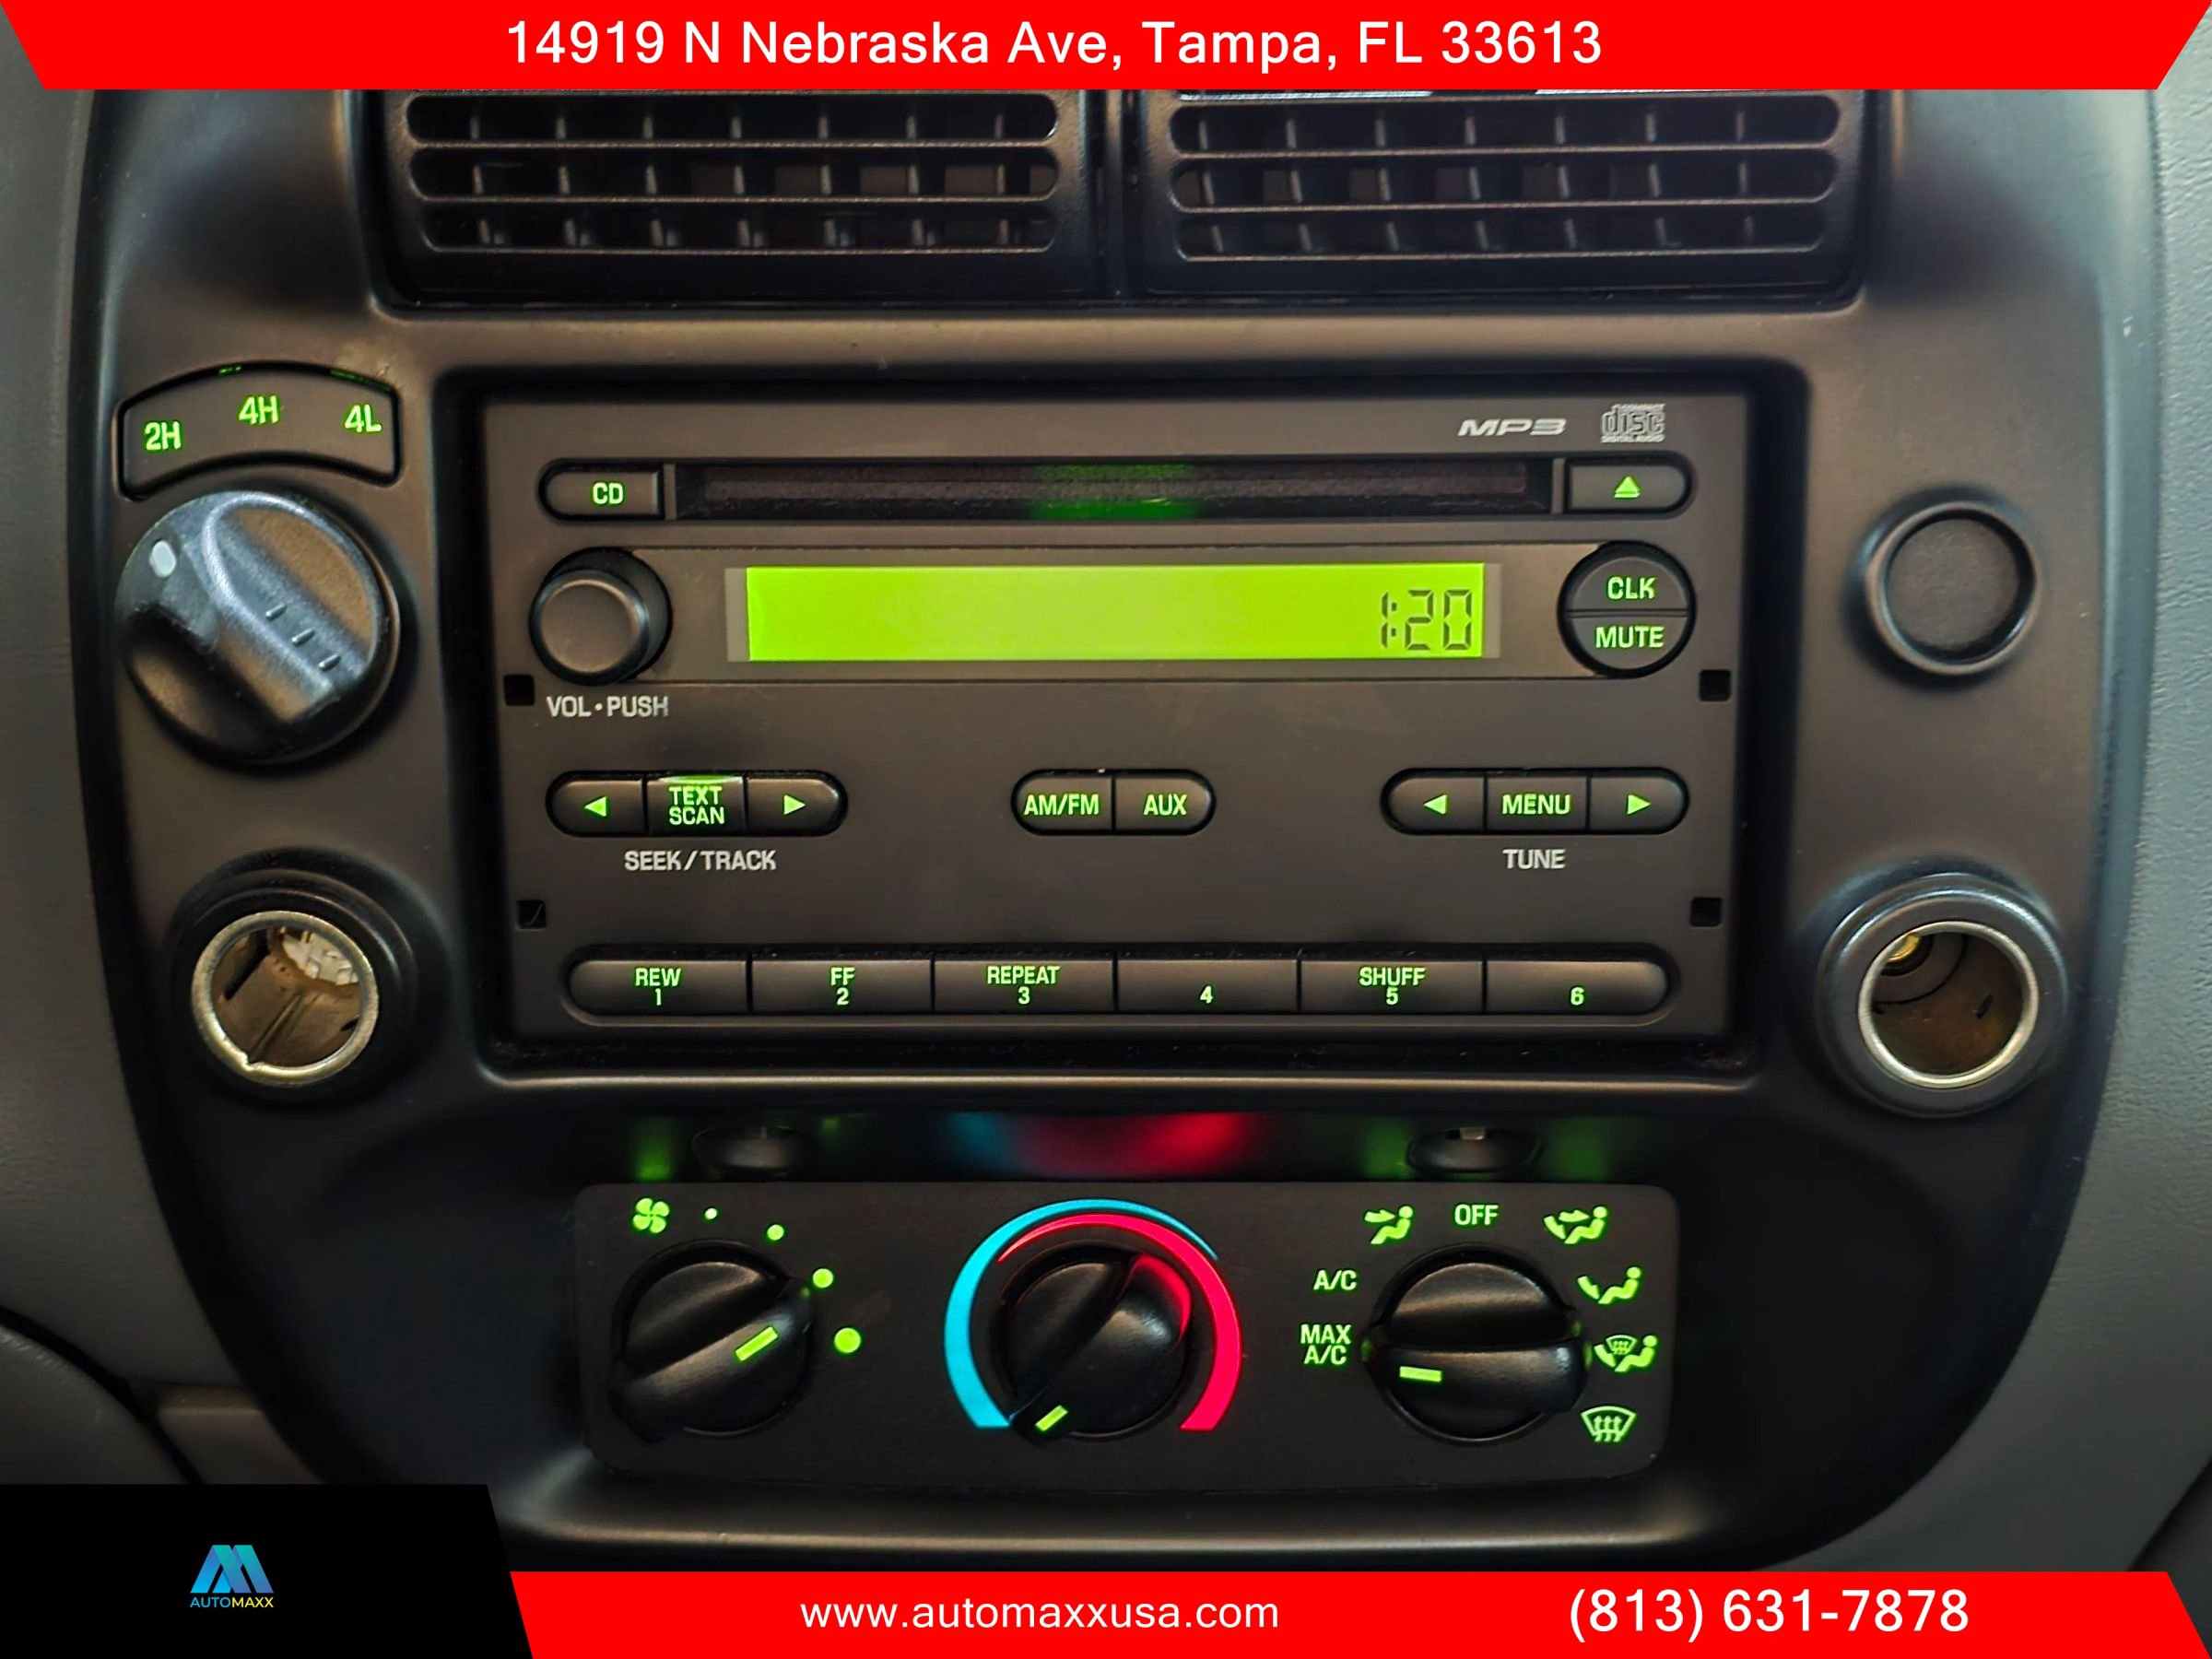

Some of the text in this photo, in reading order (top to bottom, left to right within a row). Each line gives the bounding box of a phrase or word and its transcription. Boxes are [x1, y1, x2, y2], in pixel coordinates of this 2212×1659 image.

[238, 395, 279, 425] 4H
[344, 404, 382, 433] 4L
[144, 421, 182, 451] 2H
[1457, 418, 1567, 437] MP3
[592, 482, 624, 505] CD
[1607, 576, 1655, 600] CLK
[1381, 589, 1472, 651] 1:20
[1595, 625, 1665, 649] MUTE
[668, 786, 723, 806] TEXT
[1024, 793, 1100, 816] AM/FM
[1143, 793, 1188, 816] AUX
[1501, 793, 1571, 815] MENU
[668, 806, 725, 826] SCAN
[1502, 849, 1565, 869] TUNE
[635, 967, 681, 987] REW
[830, 967, 855, 986] FF
[987, 965, 1061, 984] REPEAT
[1359, 966, 1426, 986] SHUFF
[652, 987, 662, 1006] 1
[836, 987, 849, 1006] 2
[1018, 985, 1030, 1005] 3
[1199, 985, 1214, 1004] 4
[1386, 987, 1399, 1006] 5
[1571, 986, 1584, 1006] 6
[1454, 1204, 1499, 1226] OFF
[1312, 1269, 1358, 1291] A/C
[1300, 1324, 1352, 1346] MAX
[1303, 1345, 1347, 1366] A/C
